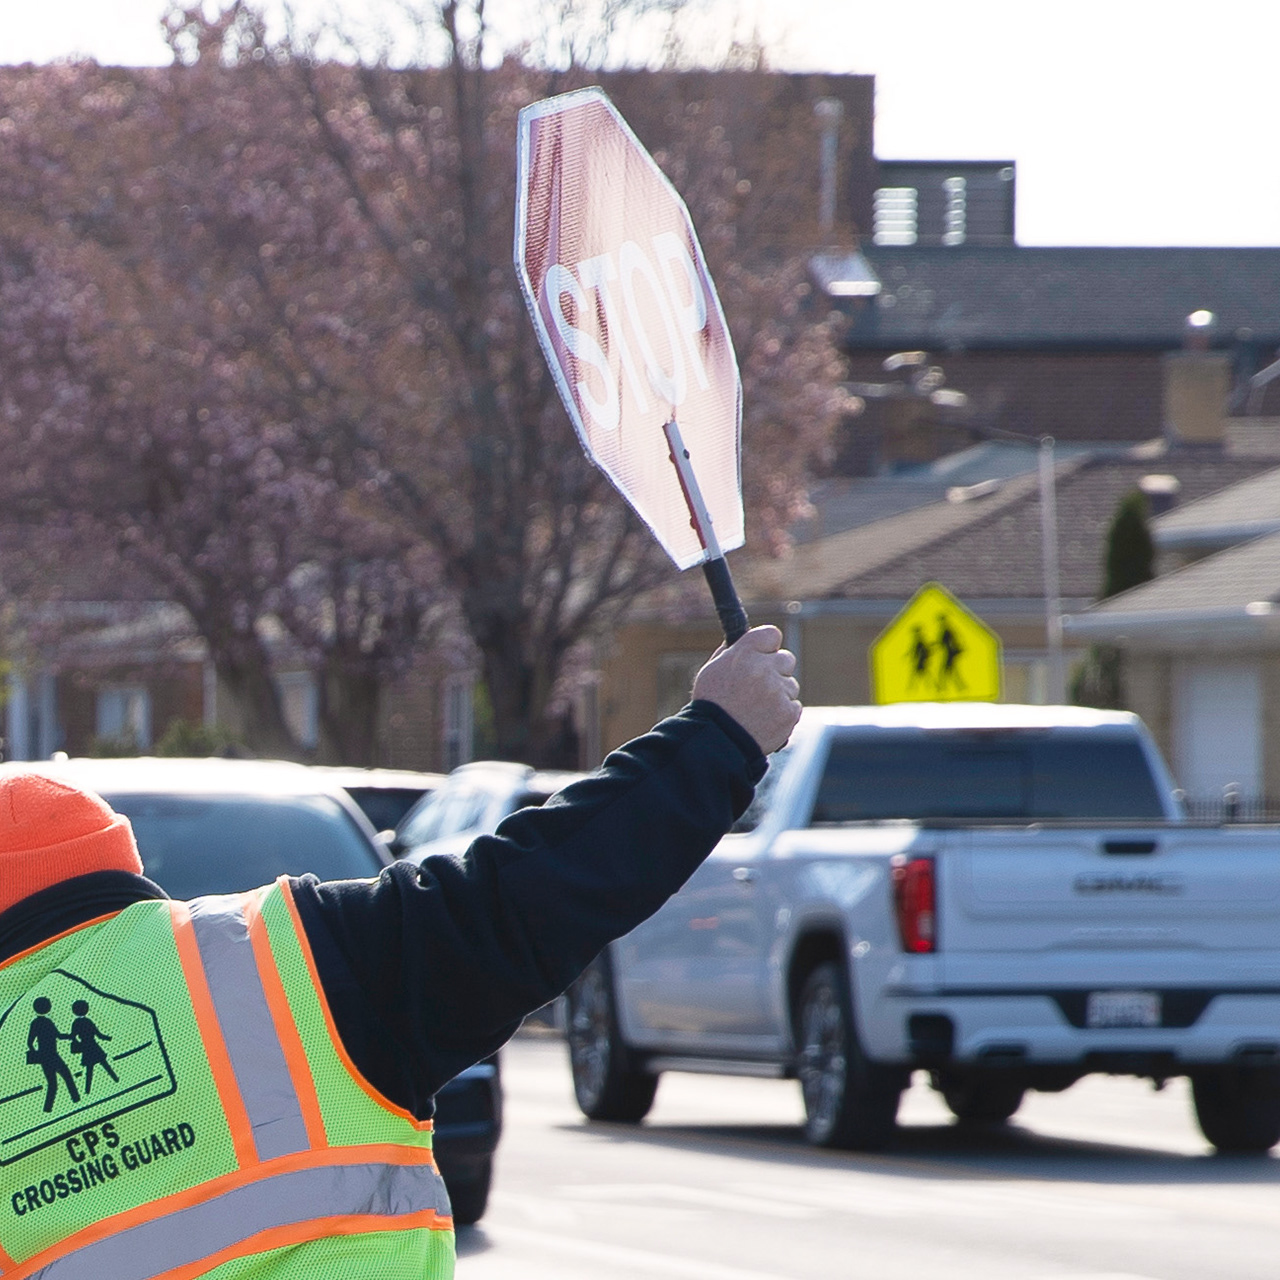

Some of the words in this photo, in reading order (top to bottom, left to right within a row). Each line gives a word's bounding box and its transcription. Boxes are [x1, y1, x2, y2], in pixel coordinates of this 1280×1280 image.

[544, 231, 709, 432] STOP
[11, 1153, 120, 1216] CROSSING
[121, 1122, 196, 1171] GUARD
[66, 1122, 121, 1164] CPS
